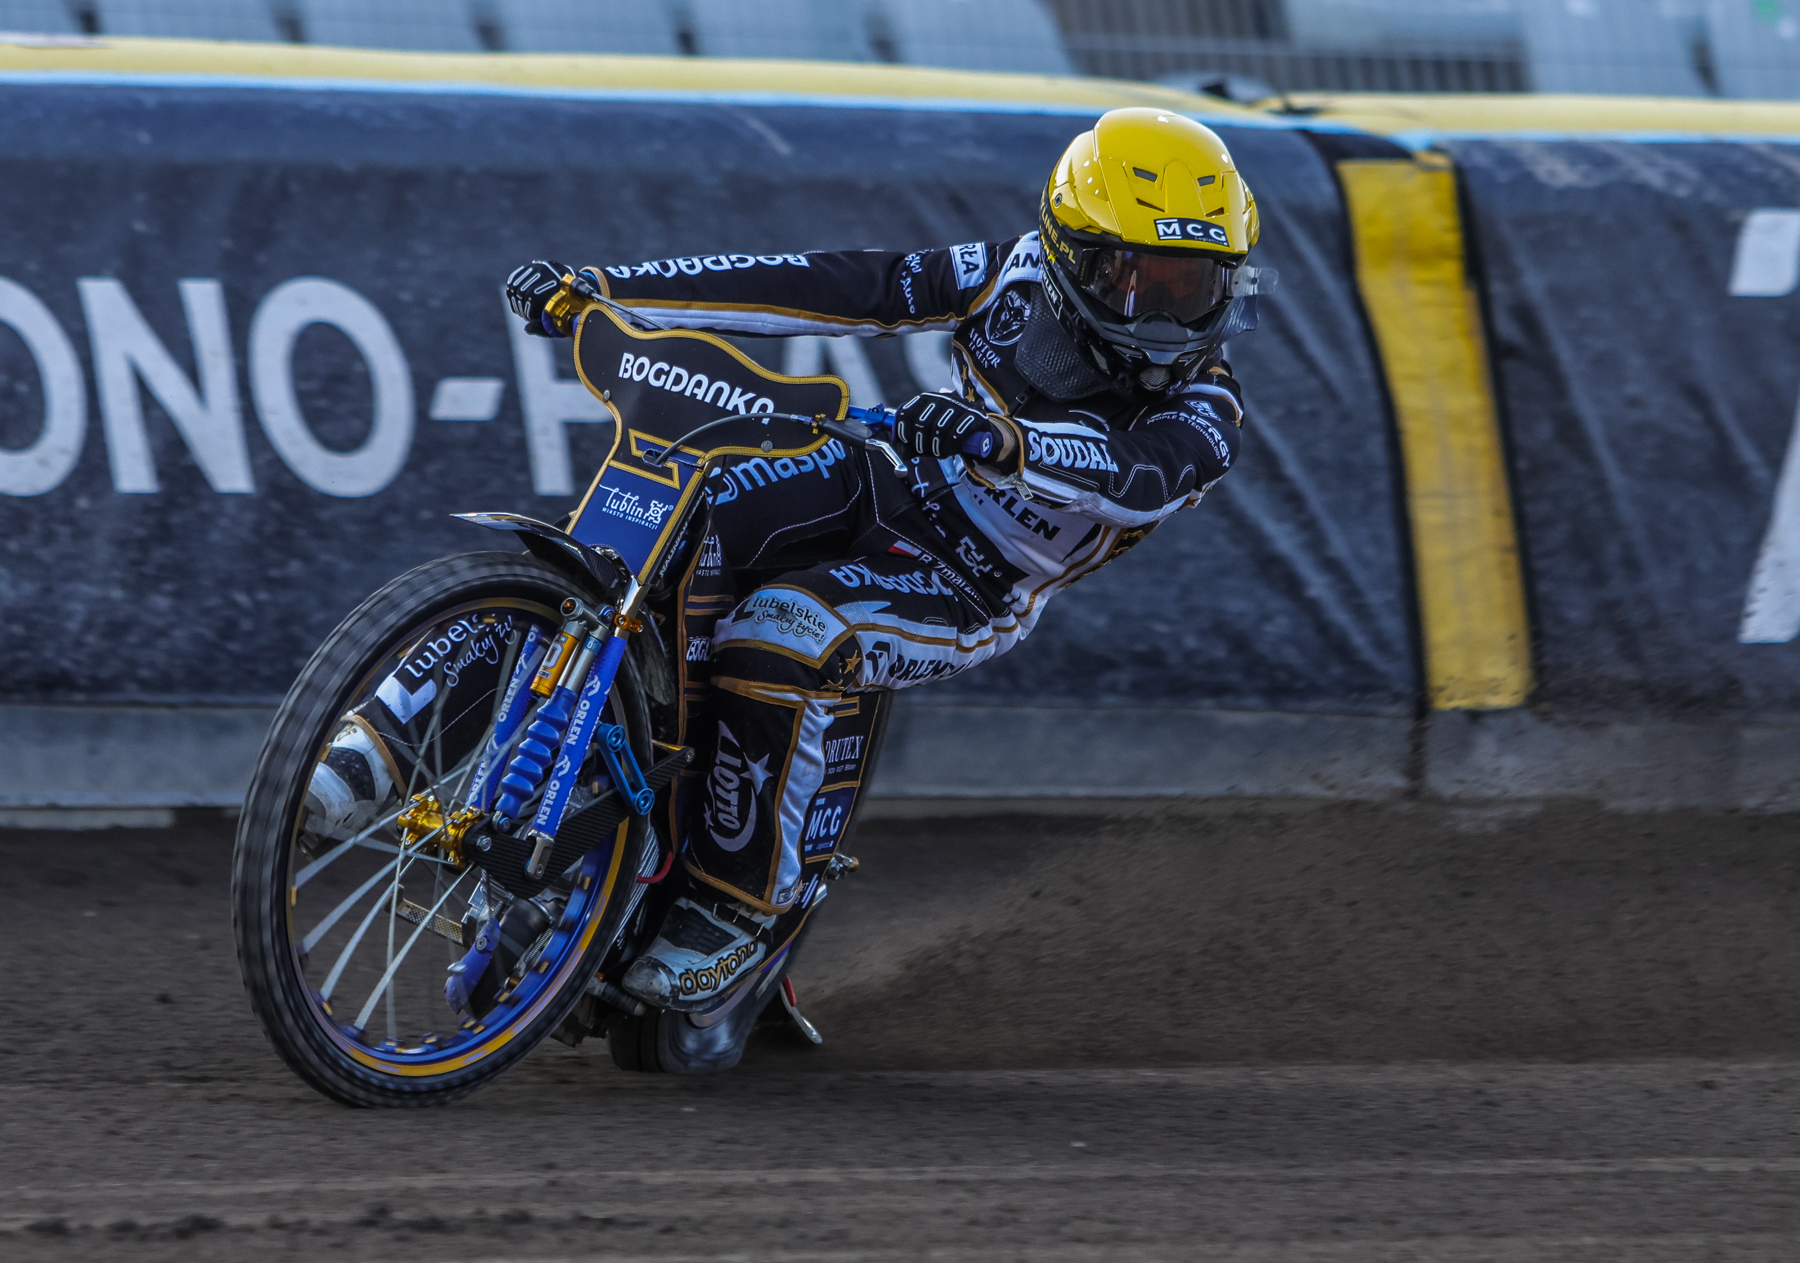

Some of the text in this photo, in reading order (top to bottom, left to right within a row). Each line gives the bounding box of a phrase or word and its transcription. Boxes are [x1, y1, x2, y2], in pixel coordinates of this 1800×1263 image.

[968, 327, 1002, 369] MOTOR
[618, 352, 775, 426] BOGDANKA
[1027, 431, 1119, 474] SOUDAL
[1187, 416, 1222, 461] TECHNOLOGY
[601, 506, 659, 531] MIASTO INSPIRACJI
[972, 477, 1062, 542] RLEN
[752, 597, 827, 633] lubelskie
[498, 678, 520, 723] ORLEN
[567, 699, 590, 746] ORLEN
[824, 734, 865, 764] DRUTEX
[537, 779, 561, 826] ORLEN
[712, 752, 743, 831] LOTTO
[805, 804, 843, 841] MCG
[679, 941, 758, 996] daytona
